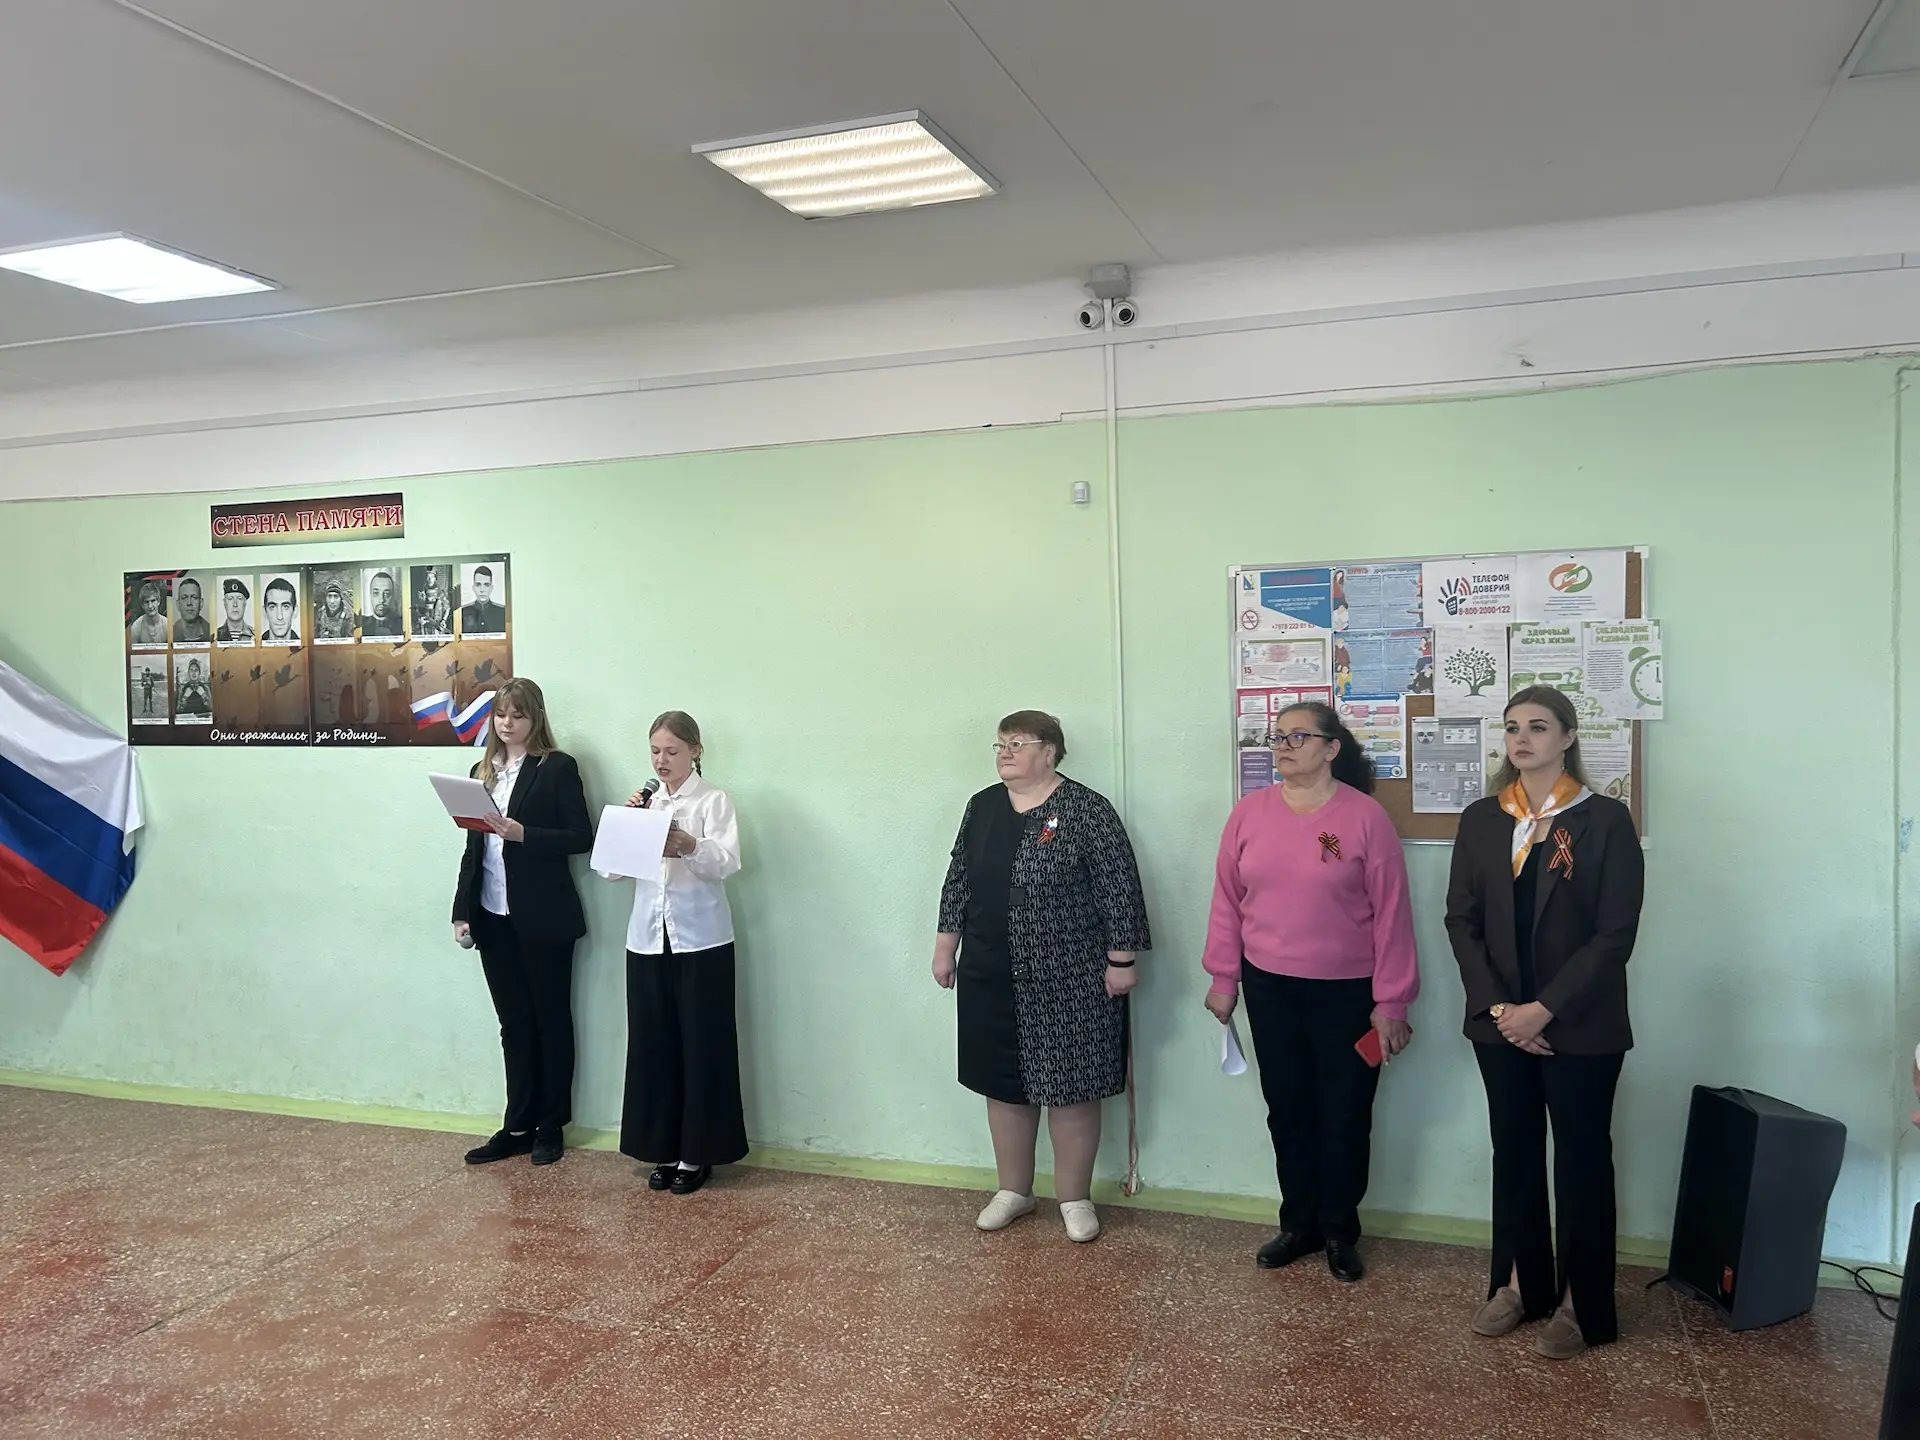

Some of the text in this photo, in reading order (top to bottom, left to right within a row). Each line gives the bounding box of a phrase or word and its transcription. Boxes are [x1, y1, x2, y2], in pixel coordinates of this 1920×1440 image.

[212, 504, 402, 537] СТЕНА ПАМЯТИ
[1472, 574, 1510, 583] ТЕЛЕФОН
[1472, 584, 1510, 594] ДОВЕРИЯ
[1458, 605, 1511, 616] 8-800-2000-122
[1243, 666, 1252, 674] 15
[210, 728, 386, 743] Они сражались за Родину...
